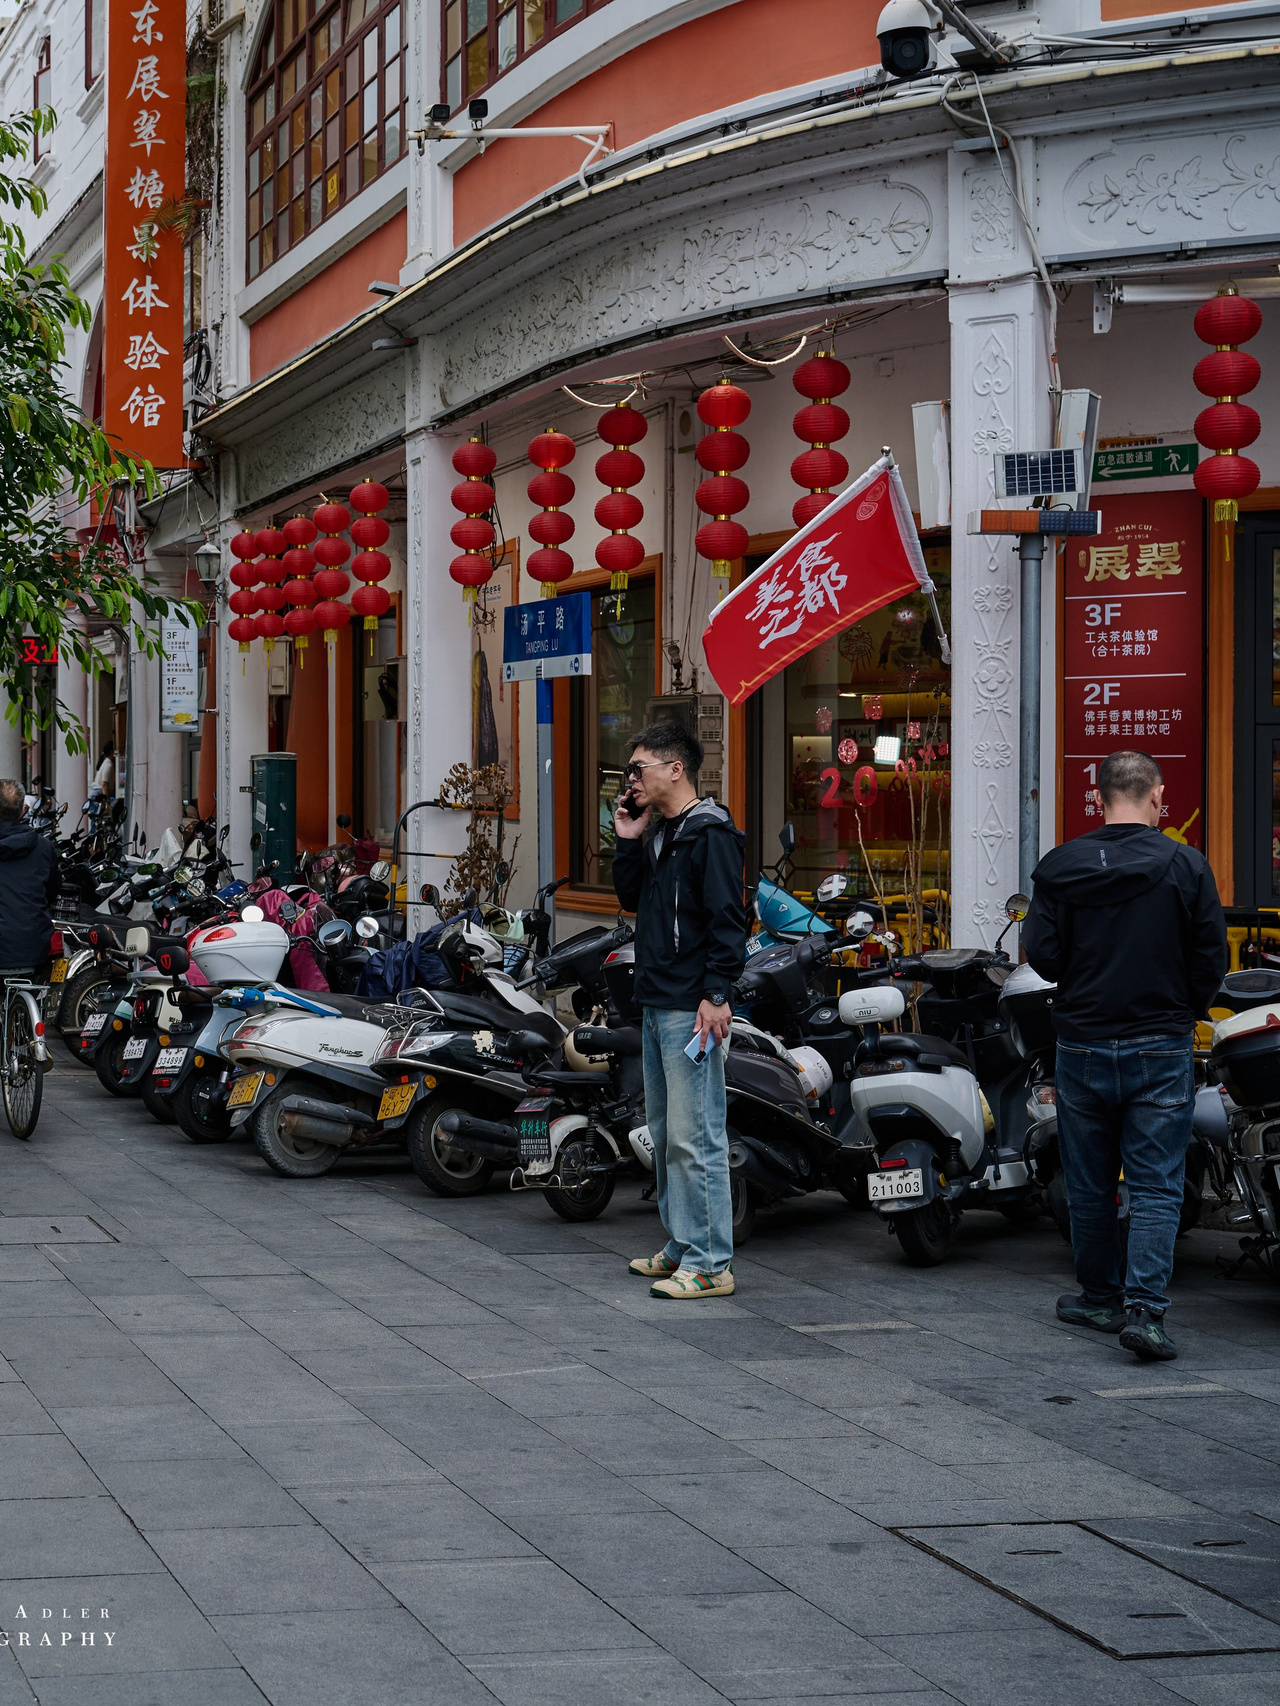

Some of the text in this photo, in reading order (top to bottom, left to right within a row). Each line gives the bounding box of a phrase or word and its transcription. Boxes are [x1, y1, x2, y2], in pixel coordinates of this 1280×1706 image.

[1097, 450, 1154, 467] 应急疏散通道
[1114, 523, 1153, 533] ZHAN CUI
[1084, 541, 1183, 583] 展翠
[520, 605, 565, 636] 汤平路
[1084, 602, 1122, 627] 3F
[166, 631, 178, 640] 3F
[1084, 629, 1159, 644] 工夫茶体验馆
[525, 638, 559, 655] TANGPING LU
[1091, 643, 1152, 658] （合十茶院）
[166, 654, 178, 662] 2F
[166, 677, 177, 686] 1F
[1083, 682, 1121, 706] 2F
[1084, 708, 1183, 723] 佛手香黄博物工坊
[1084, 723, 1171, 737] 佛手果主题饮吧
[871, 1180, 921, 1198] 211003
